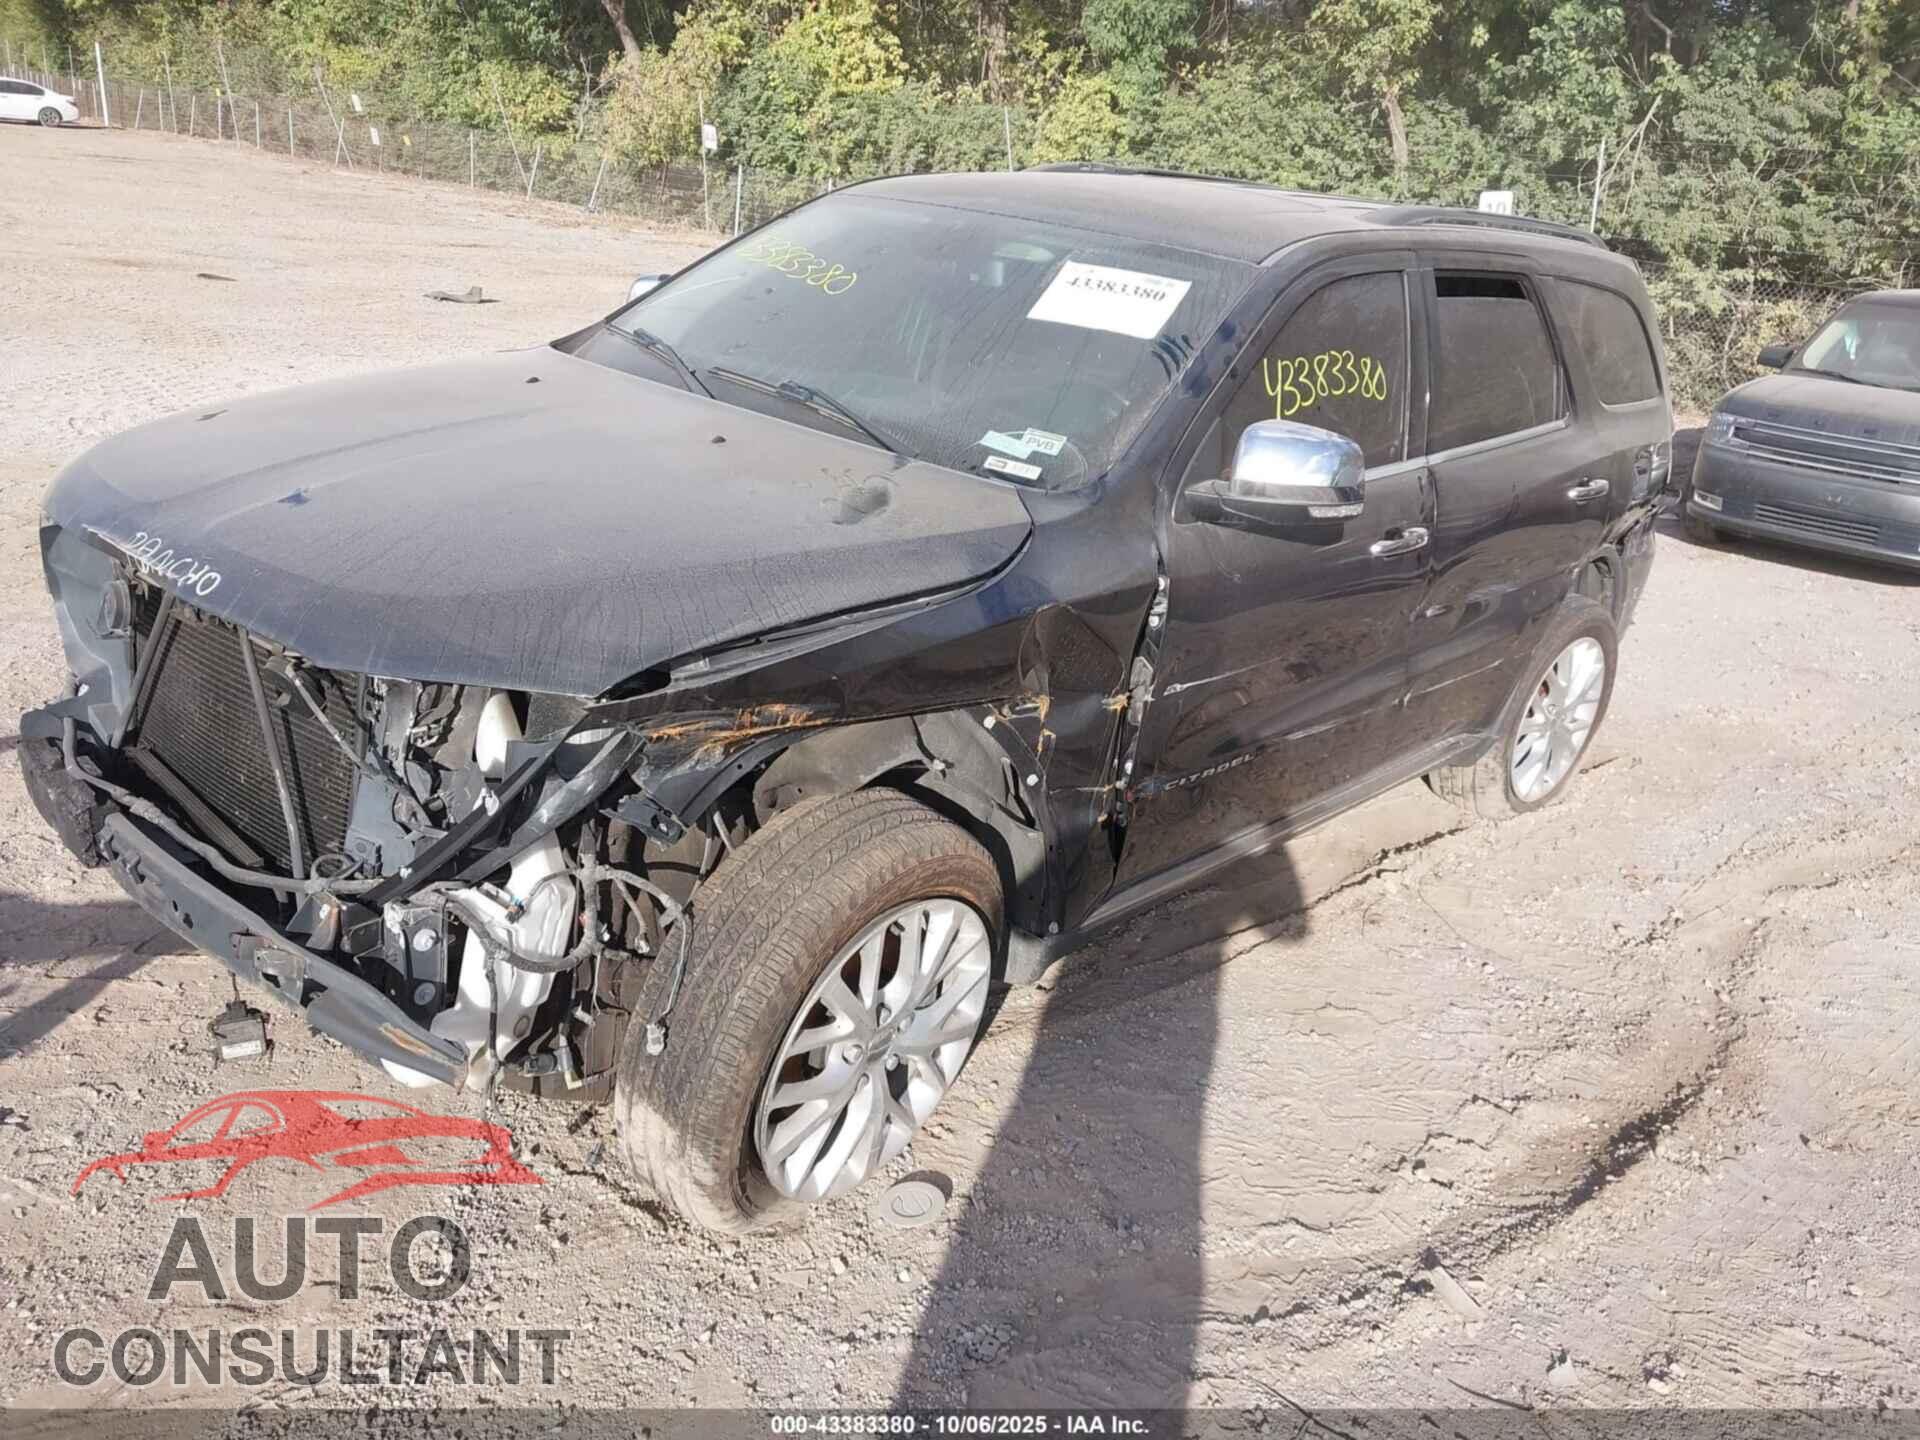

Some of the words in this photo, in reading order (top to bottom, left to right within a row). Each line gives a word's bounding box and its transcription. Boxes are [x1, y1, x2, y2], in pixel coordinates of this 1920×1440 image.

[1066, 276, 1167, 302] 43383380
[1263, 350, 1388, 419] 43383380
[1025, 436, 1056, 451] PVB
